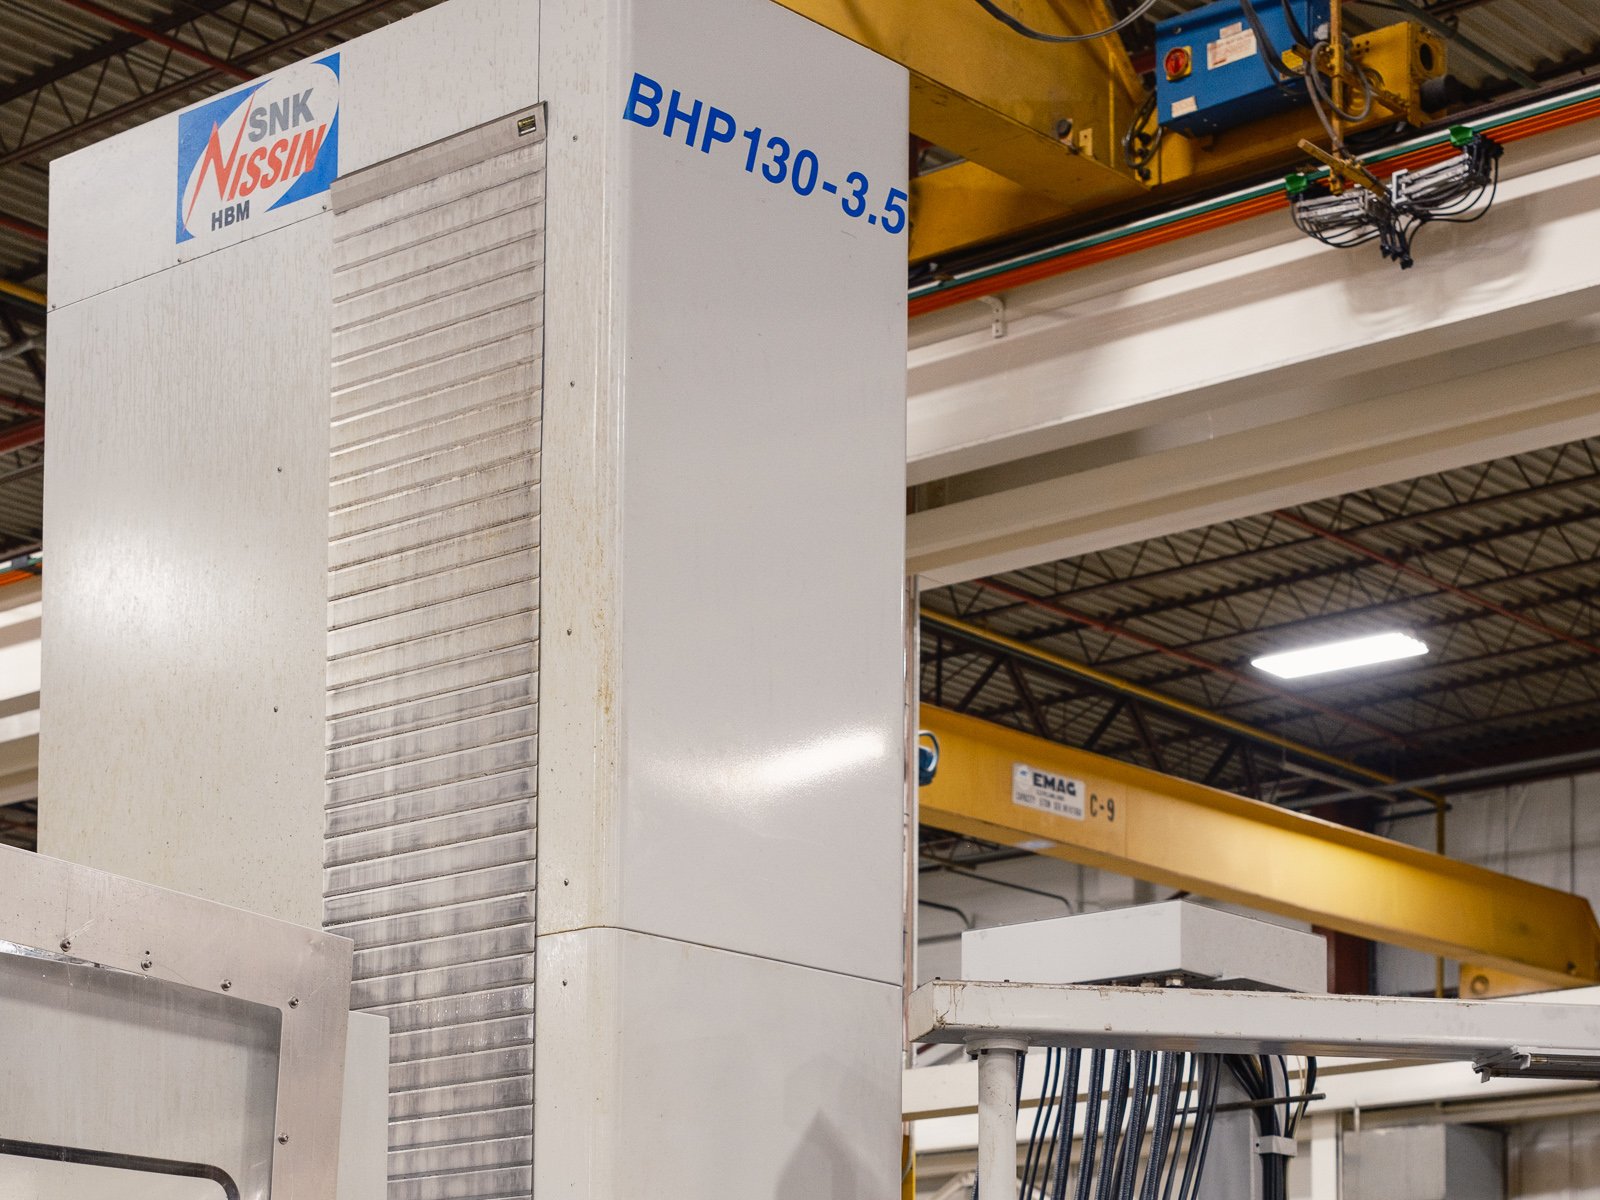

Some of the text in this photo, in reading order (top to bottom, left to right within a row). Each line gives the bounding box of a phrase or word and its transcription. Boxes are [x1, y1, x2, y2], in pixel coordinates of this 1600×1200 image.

[248, 87, 315, 142] SNK
[182, 90, 328, 232] NISSIN
[622, 72, 908, 234] BHP130-3.5
[211, 200, 250, 231] HBM
[1033, 772, 1076, 796] EMAG
[1090, 793, 1115, 822] C-9
